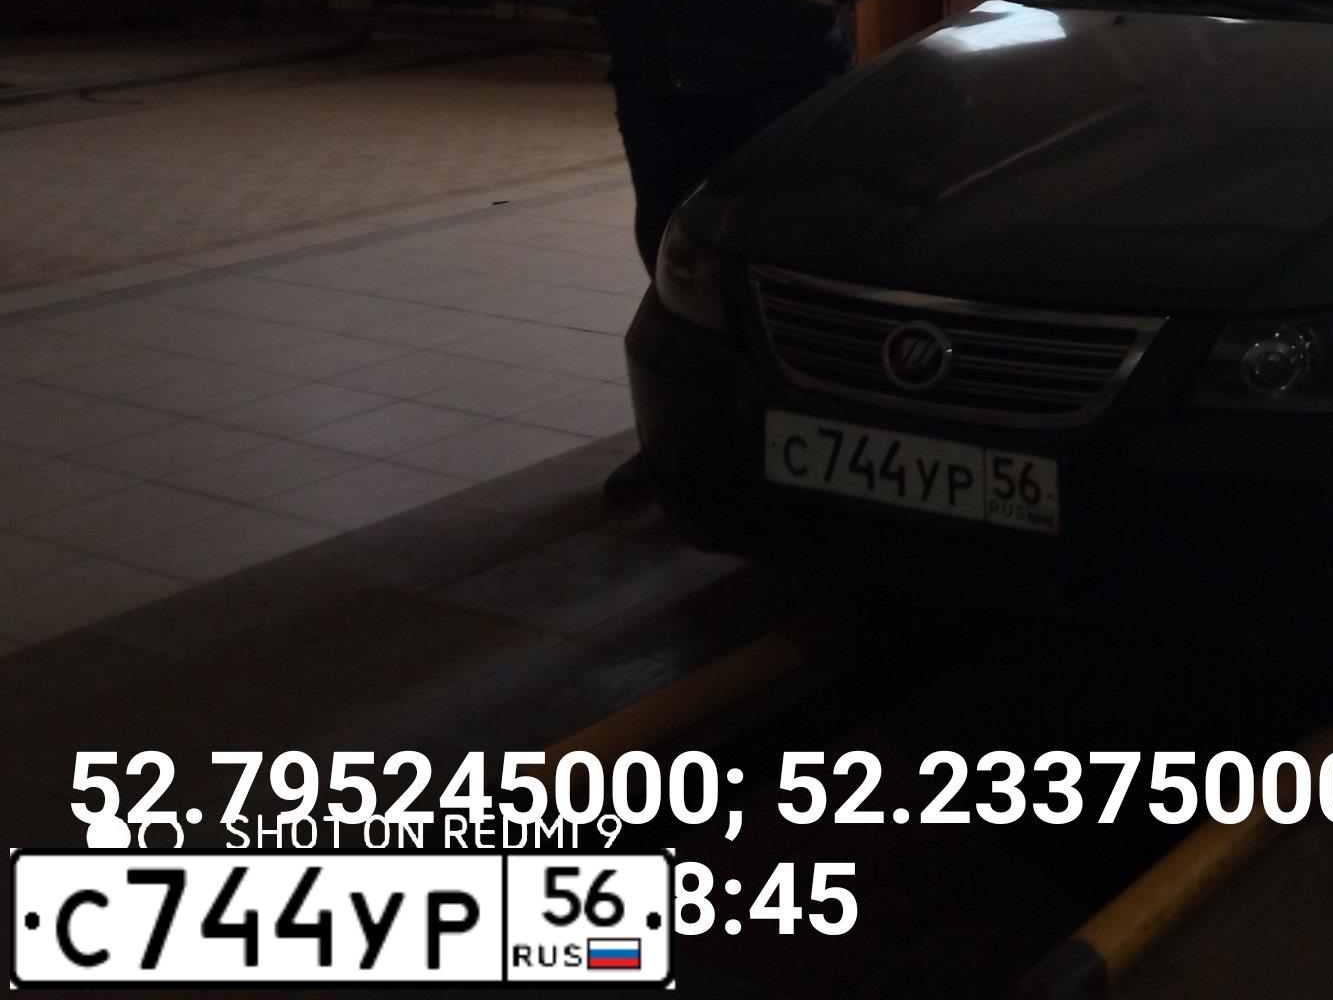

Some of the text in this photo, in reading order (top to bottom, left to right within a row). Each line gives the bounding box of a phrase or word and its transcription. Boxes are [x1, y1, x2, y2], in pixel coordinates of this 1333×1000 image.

[782, 427, 1042, 507] С744УР 56
[989, 501, 1026, 519] RUS
